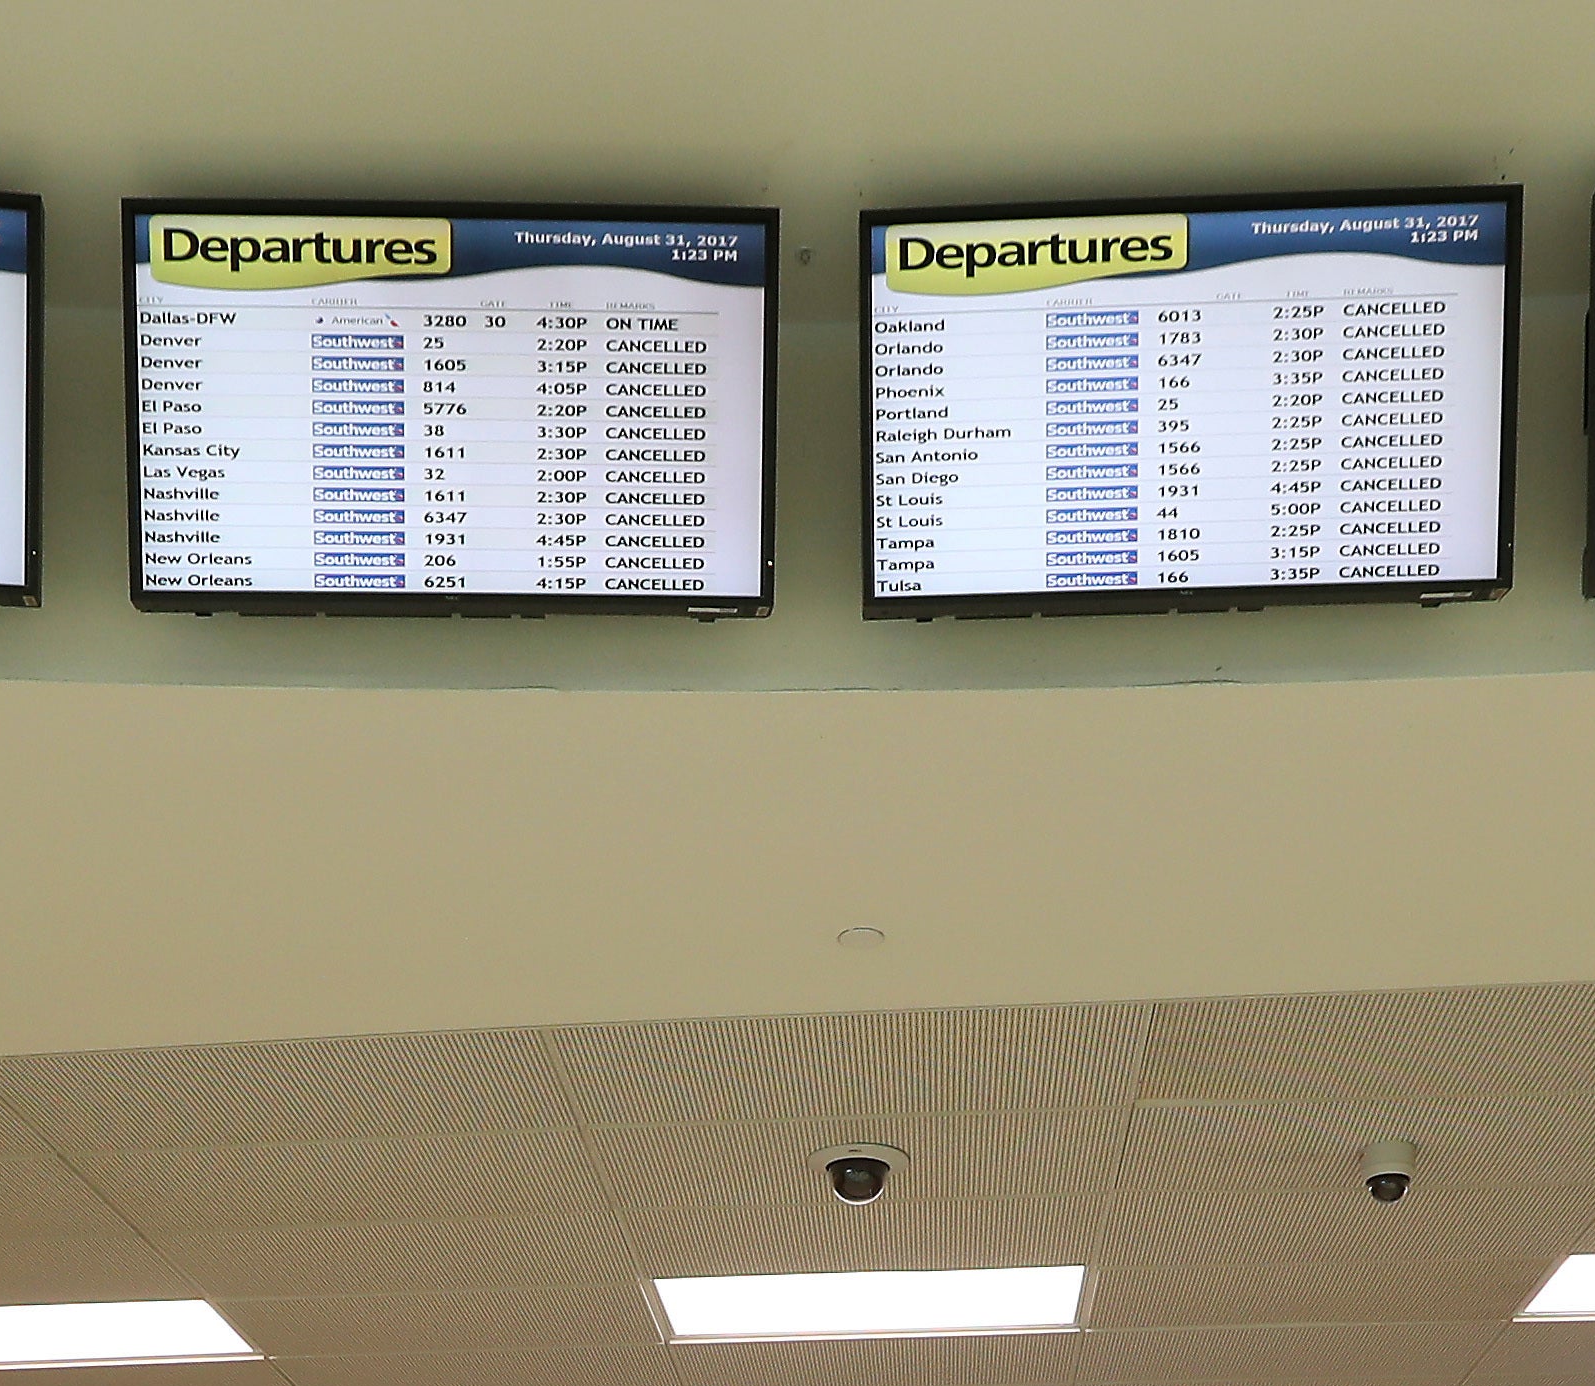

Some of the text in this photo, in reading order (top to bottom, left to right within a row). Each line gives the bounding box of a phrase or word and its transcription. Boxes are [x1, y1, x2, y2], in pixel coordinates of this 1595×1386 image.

[1252, 214, 1480, 236] Thursday, August 31, 2017
[514, 231, 738, 248] Thursday, August 31, 2017
[1410, 229, 1479, 244] 1:23 PM
[163, 227, 437, 273] Departures
[671, 248, 738, 262] 1:23 PM
[898, 233, 1174, 279] Departures
[139, 312, 679, 331] Dallas-DFW American 3280 30 4:30P ON TIME
[874, 301, 1447, 334] Oakland Southwest 6013 2:25P CANCELLED
